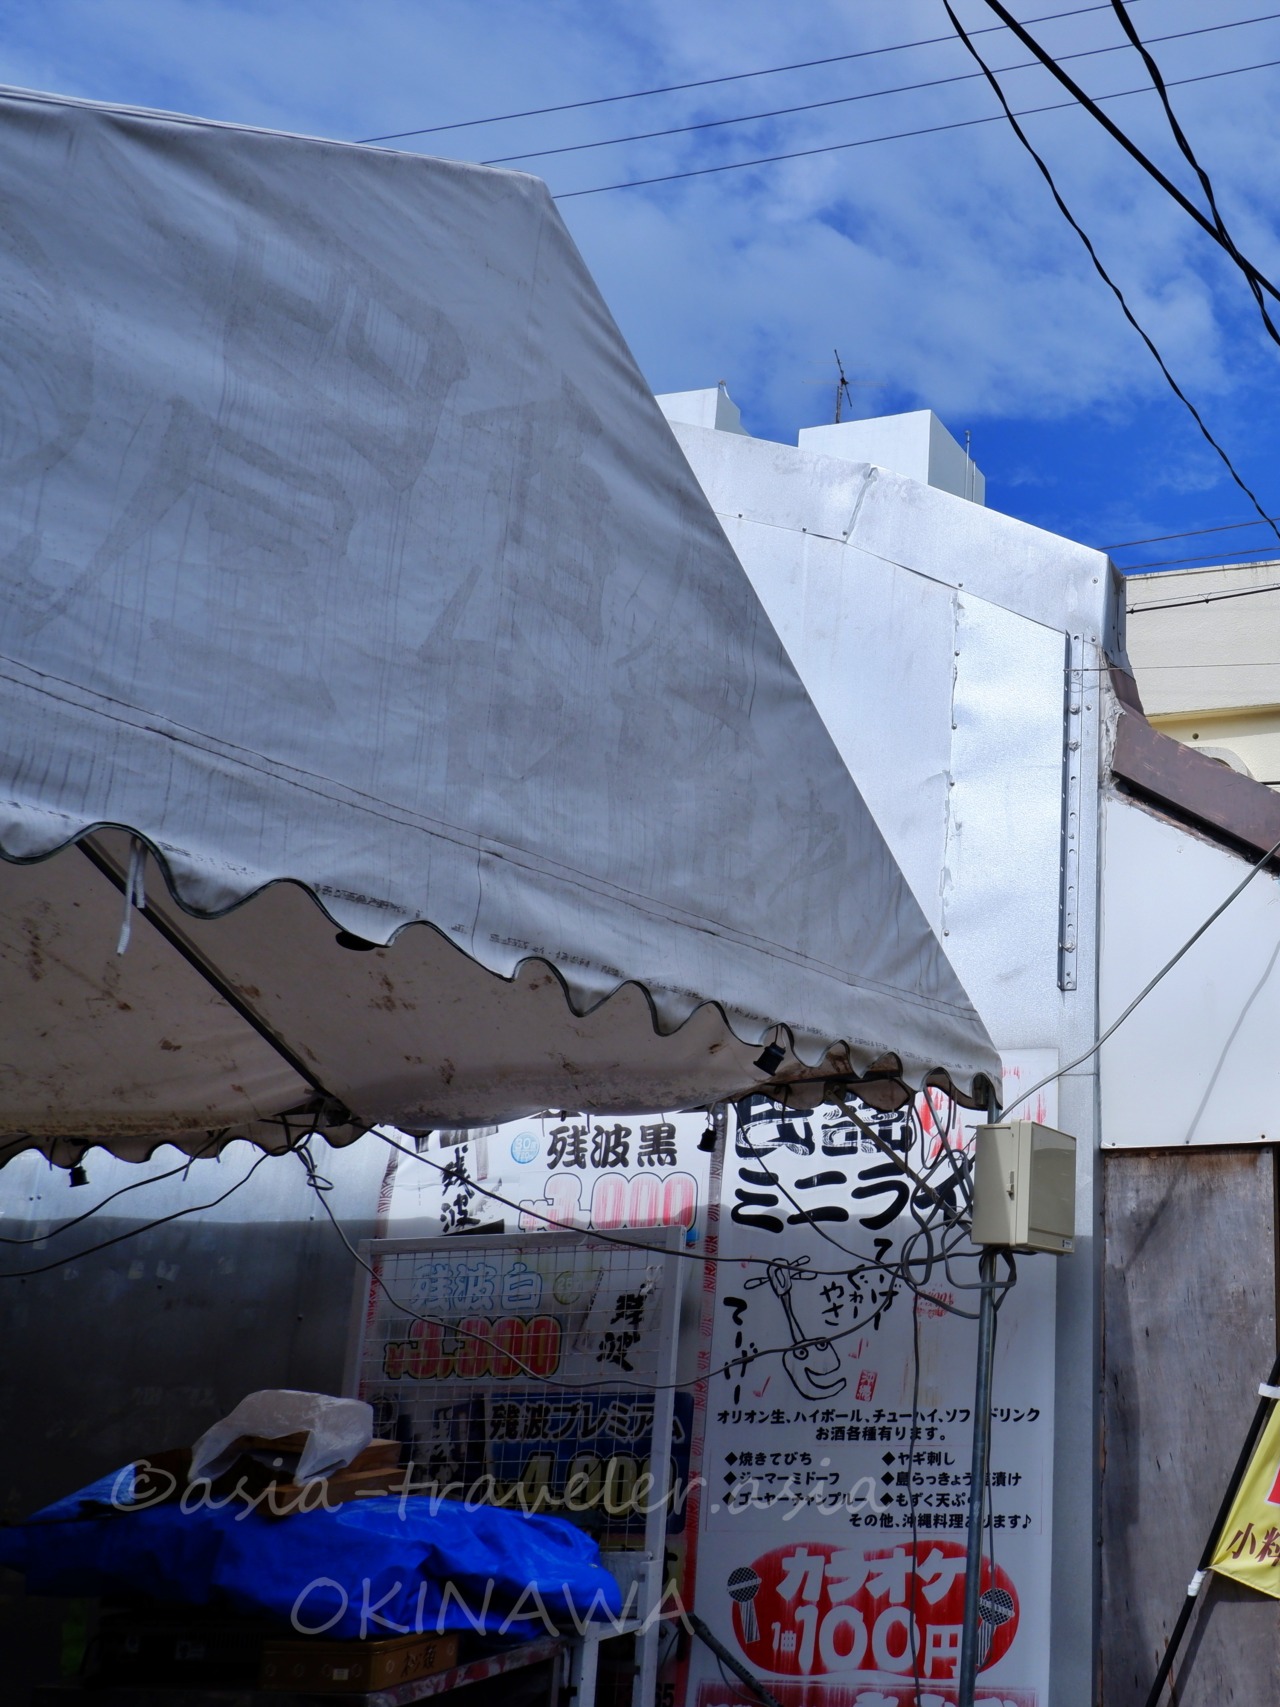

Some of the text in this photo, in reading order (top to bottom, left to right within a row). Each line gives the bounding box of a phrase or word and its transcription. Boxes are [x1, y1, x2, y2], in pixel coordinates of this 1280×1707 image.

[546, 1123, 678, 1169] 残波黒
[730, 1158, 976, 1234] ミニライ
[411, 1261, 544, 1312] 残波白
[716, 1407, 1041, 1425] オリオン生、ハイボール、チューハイ、ソフドリンク
[815, 1426, 947, 1442] お酒各種有ります。
[739, 1452, 812, 1467] 焼きてびち
[898, 1452, 956, 1467] ヤギ刺し
[776, 1547, 967, 1605] カラオケ
